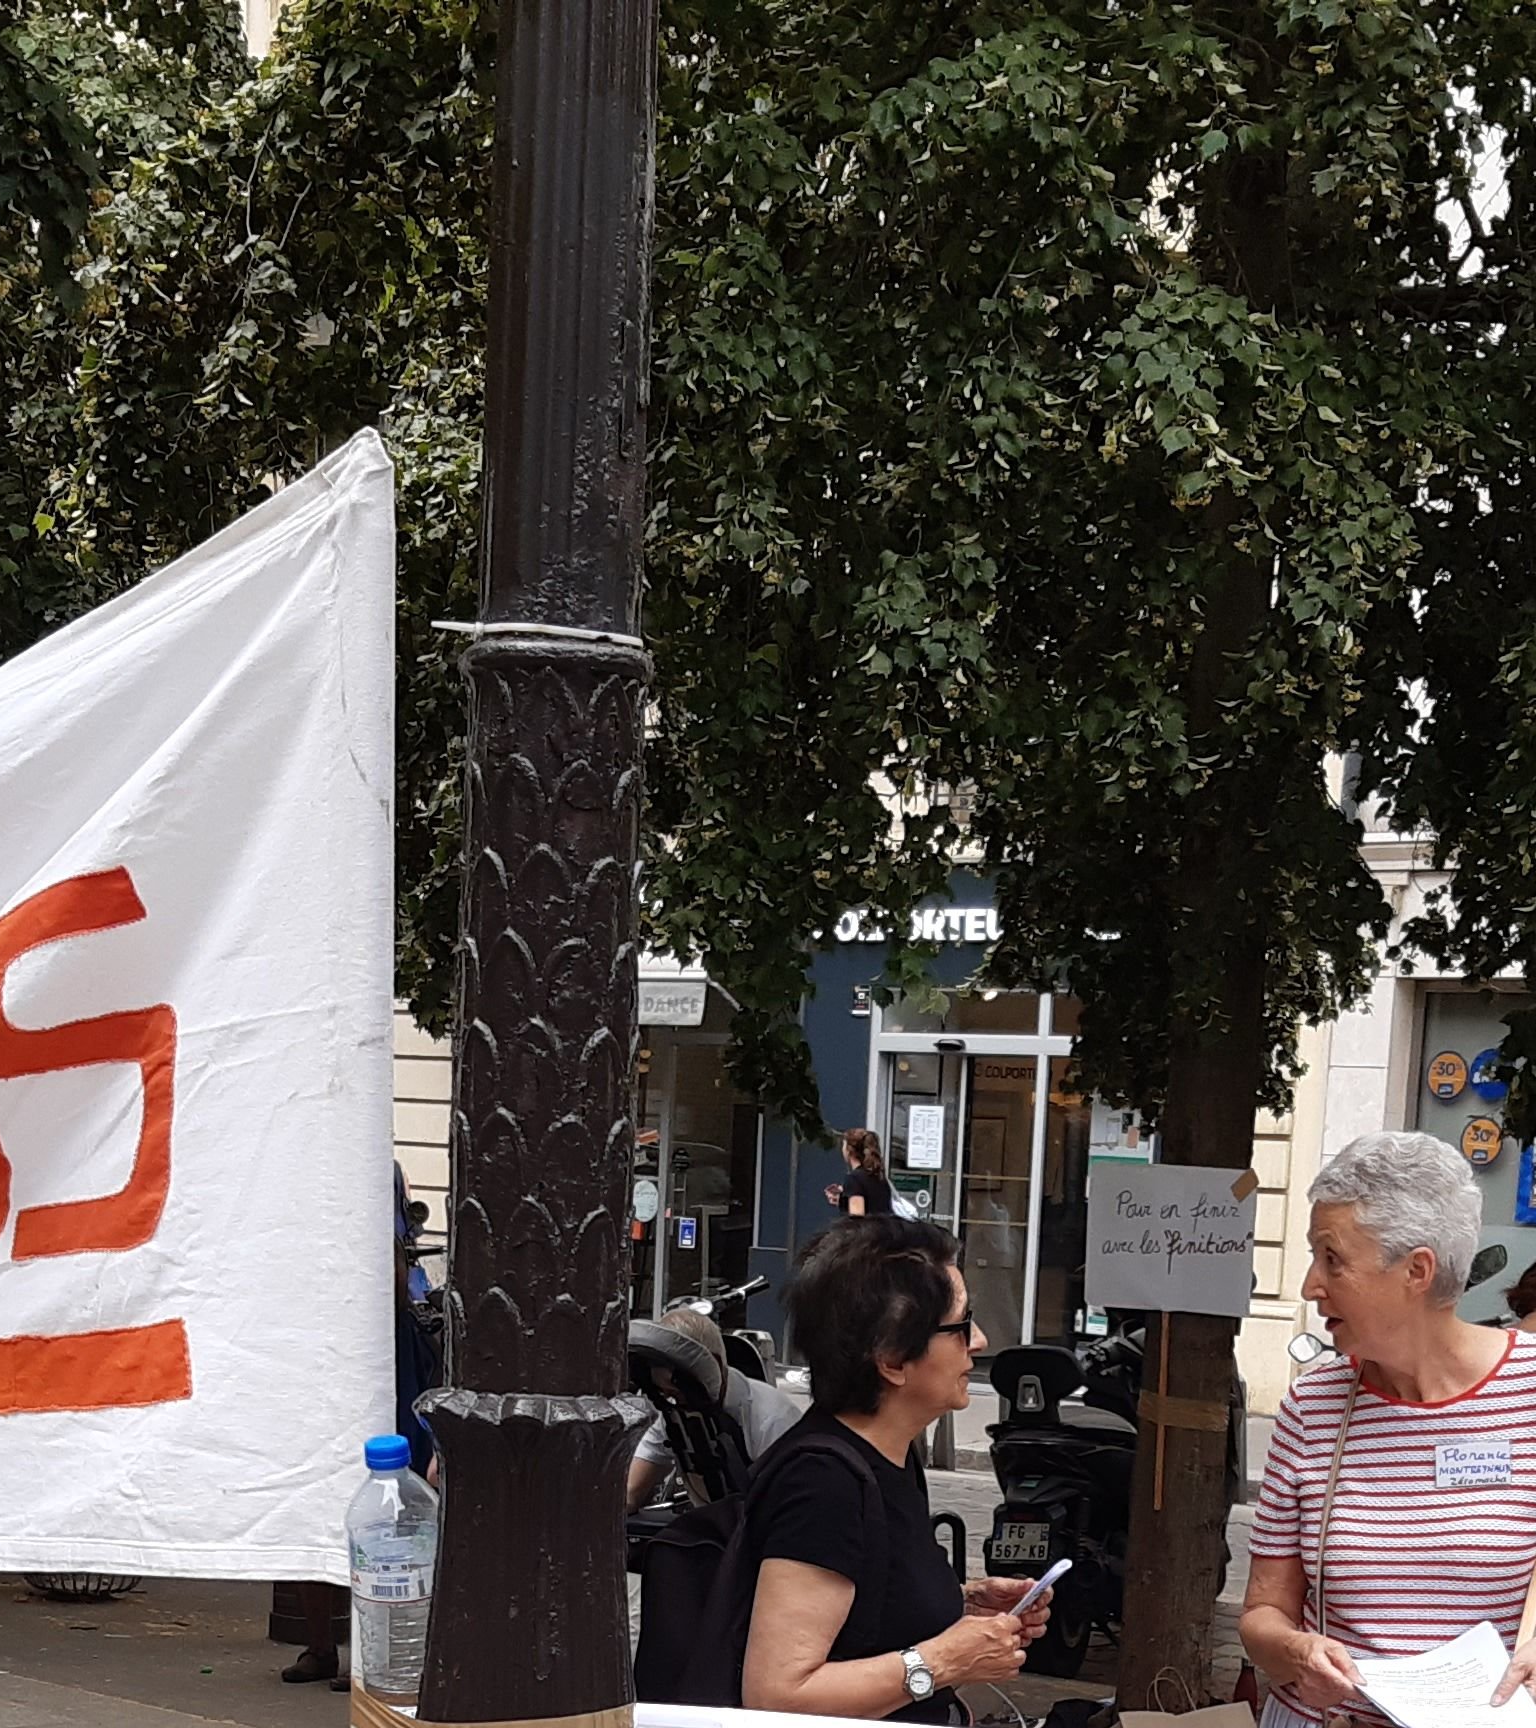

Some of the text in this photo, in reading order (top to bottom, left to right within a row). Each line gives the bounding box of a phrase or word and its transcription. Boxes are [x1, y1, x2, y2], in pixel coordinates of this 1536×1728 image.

[1116, 1190, 1241, 1233] Pour en finir
[1102, 1239, 1134, 1254] avec
[1139, 1229, 1161, 1255] les
[995, 1544, 1046, 1558] 567-KB
